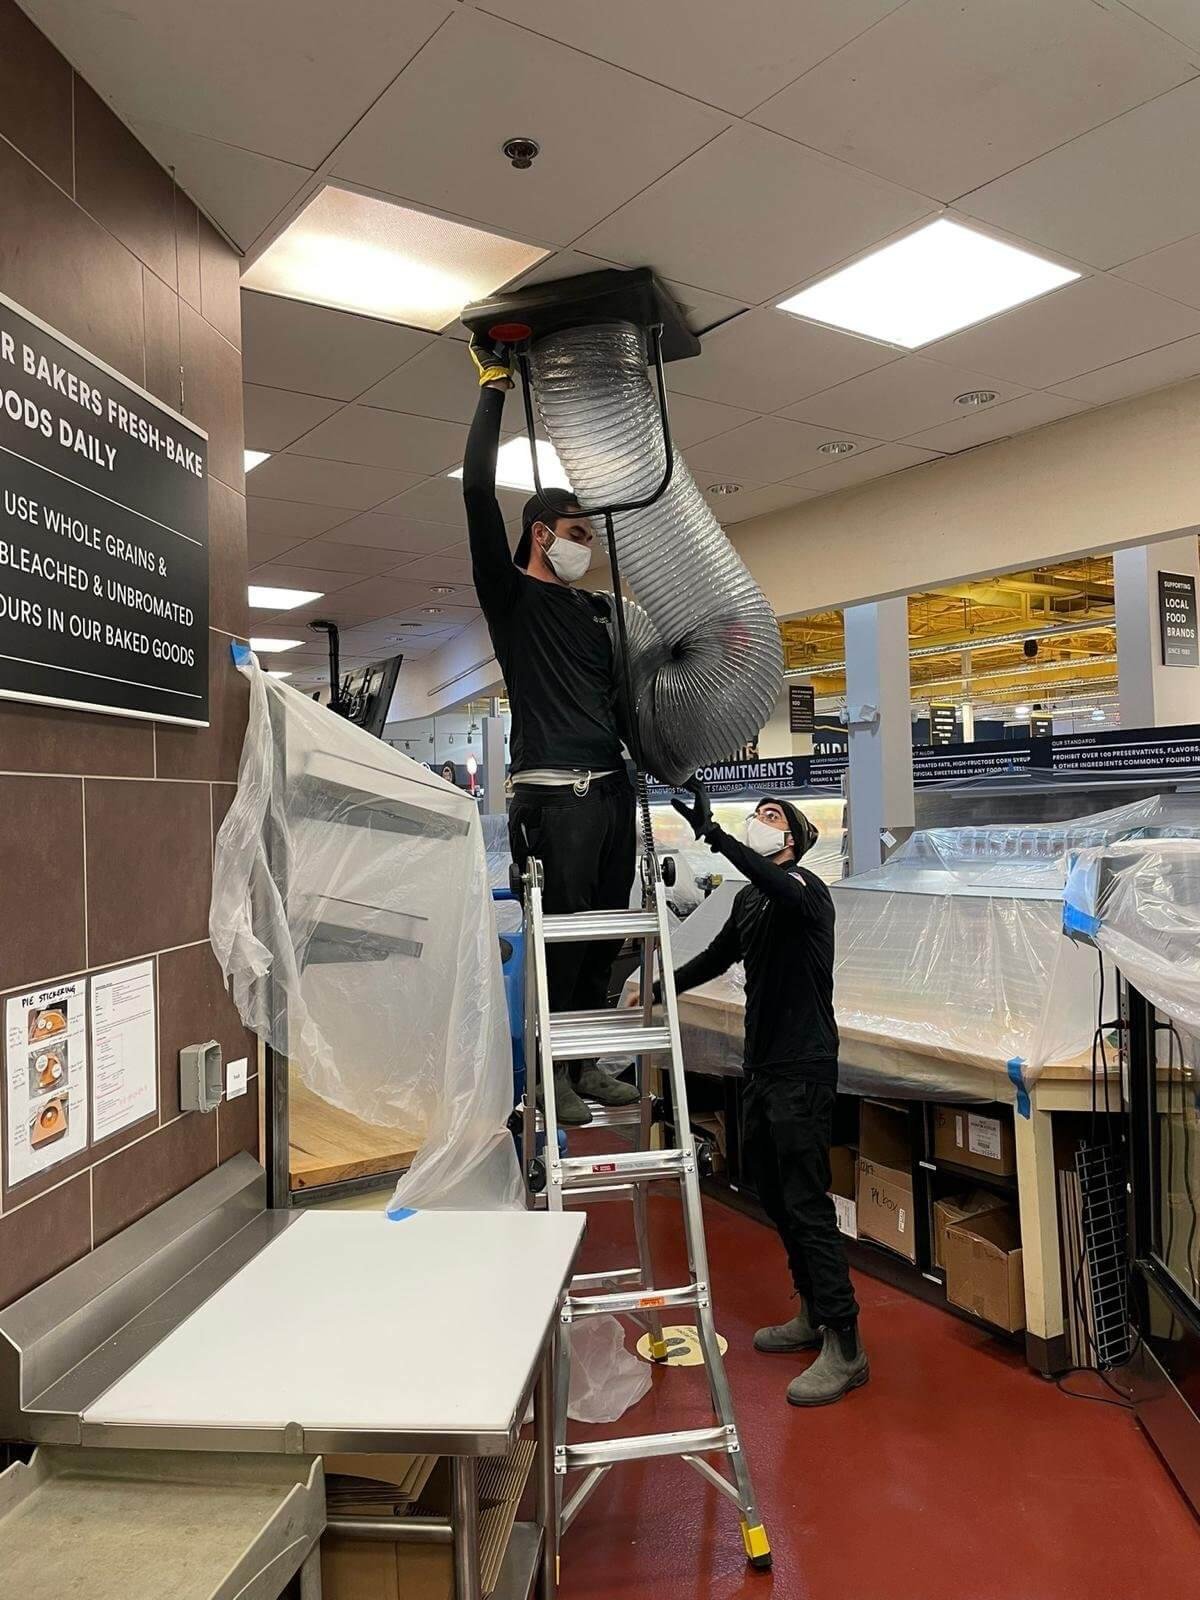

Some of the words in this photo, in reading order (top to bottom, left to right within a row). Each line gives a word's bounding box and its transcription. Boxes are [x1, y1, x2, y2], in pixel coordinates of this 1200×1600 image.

[22, 343, 102, 416] BAKERS
[107, 397, 203, 478] FRESH-BAKE
[0, 388, 53, 438] ODS
[59, 417, 117, 472] DAILY
[5, 489, 39, 526] USE
[43, 506, 102, 551] WHOLE
[105, 534, 155, 573] GRAINS
[158, 556, 168, 577] &
[1164, 581, 1191, 590] SUPPORTING
[93, 574, 104, 598] &
[107, 579, 194, 627] UNBROMATED
[1165, 598, 1189, 609] LOCAL
[1166, 612, 1186, 623] FOOD
[47, 607, 64, 633] IN
[69, 615, 101, 643] OUR
[105, 624, 150, 655] BAKED
[152, 638, 195, 667] GOODS
[1167, 627, 1195, 639] BRANDS
[1064, 738, 1097, 746] STANDARDS
[953, 758, 995, 767] HIGH-FRUCTOSE
[996, 757, 1011, 765] CORN
[1013, 756, 1032, 764] SYRUP
[1053, 753, 1081, 761] PROHIBIT
[1082, 751, 1099, 759] OVER
[1080, 758, 1123, 769] INGREDIENTS
[1123, 757, 1164, 766] COMMONLY
[1166, 755, 1191, 763] FOUND
[695, 761, 794, 782] COMMITMENTS
[934, 768, 967, 776] SWEETENERS
[778, 780, 795, 788] ELSE
[21, 995, 34, 1008] PIE
[38, 984, 76, 1003] STICKERING
